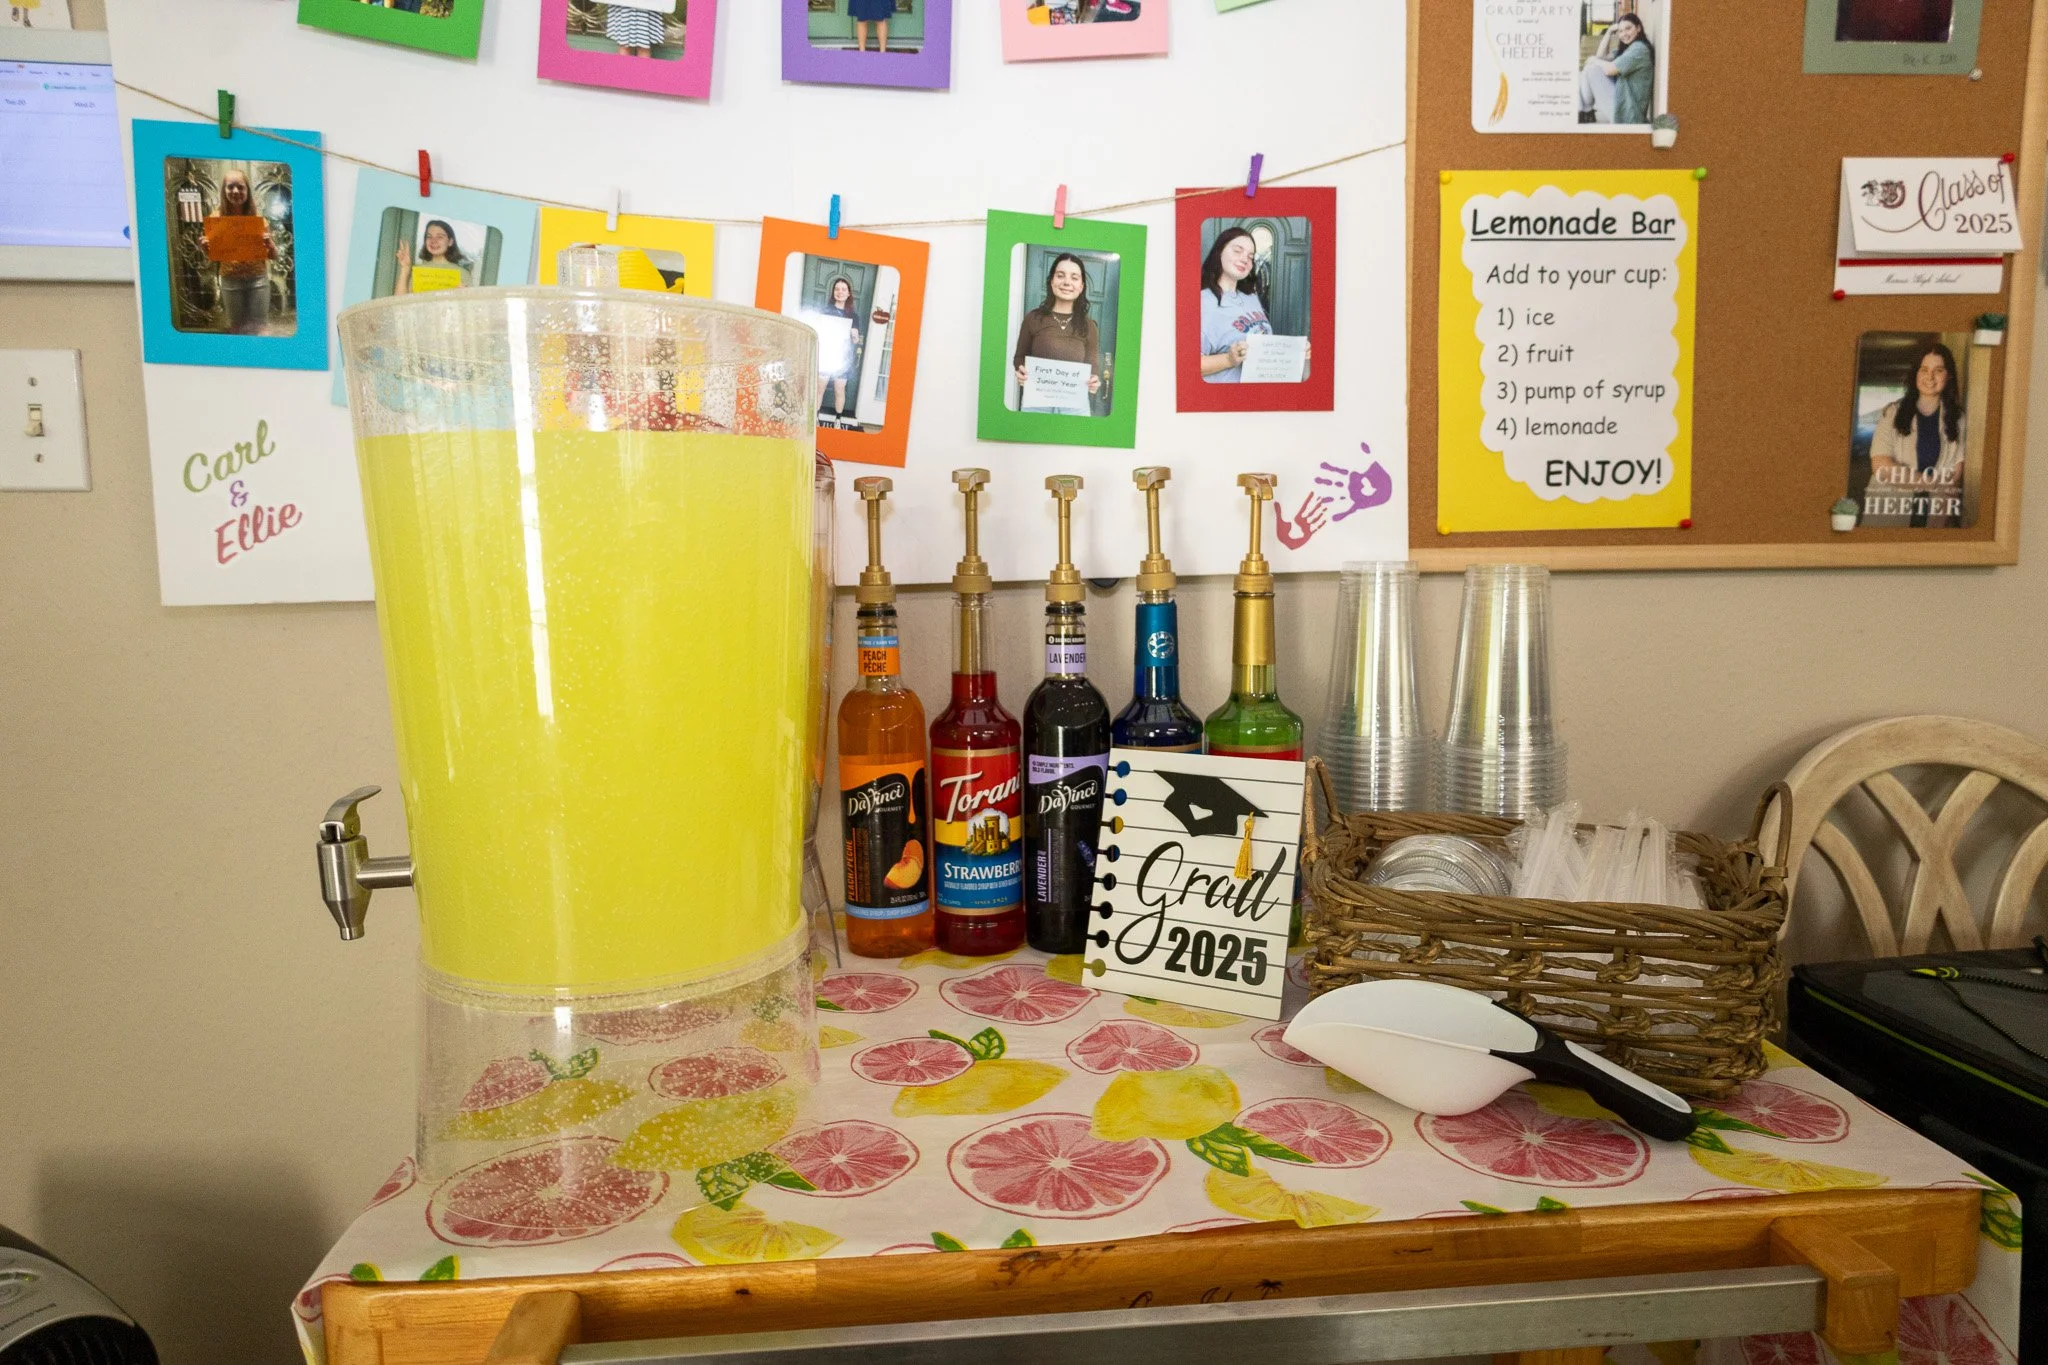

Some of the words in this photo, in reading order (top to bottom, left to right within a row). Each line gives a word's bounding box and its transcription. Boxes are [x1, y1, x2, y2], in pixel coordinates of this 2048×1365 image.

[1485, 5, 1524, 16] GRAD
[1530, 5, 1575, 16] PARTY
[1496, 33, 1547, 46] CHLOE
[1502, 47, 1554, 59] HEETER
[1917, 170, 1986, 232] Class
[1988, 160, 2005, 204] of
[1471, 208, 1617, 236] Lemonade
[1632, 211, 1676, 235] Bar
[1955, 213, 2013, 234] 2025
[1486, 263, 1530, 284] Add
[1537, 266, 1560, 284] to
[1568, 269, 1616, 290] your
[1624, 268, 1667, 290] cup:
[1497, 308, 1514, 330] 1)
[1526, 308, 1556, 326] ice
[1498, 344, 1518, 367] 2)
[1526, 343, 1574, 364] fruit
[1035, 365, 1053, 374] First
[1055, 368, 1069, 378] Day
[1036, 377, 1058, 386] Junior
[1497, 381, 1517, 404] 3)
[1525, 385, 1576, 405] pump
[1583, 379, 1605, 399] of
[1612, 383, 1666, 403] syrup
[1496, 417, 1517, 440] 4)
[1525, 416, 1618, 436] lemonade
[183, 419, 276, 493] Carl
[1545, 458, 1662, 487] ENJOY!
[1875, 466, 1955, 485] CHLOE
[229, 480, 249, 508] &
[1864, 496, 1961, 516] HEETER
[215, 503, 303, 565] Ellie
[863, 650, 887, 661] PEACH
[848, 781, 905, 816] DaVinci
[940, 766, 1020, 825] Torani
[1040, 779, 1098, 814] DaVinci
[1037, 855, 1047, 902] LAVENDER
[1115, 841, 1287, 965] Grad
[1165, 926, 1268, 986] 2025
